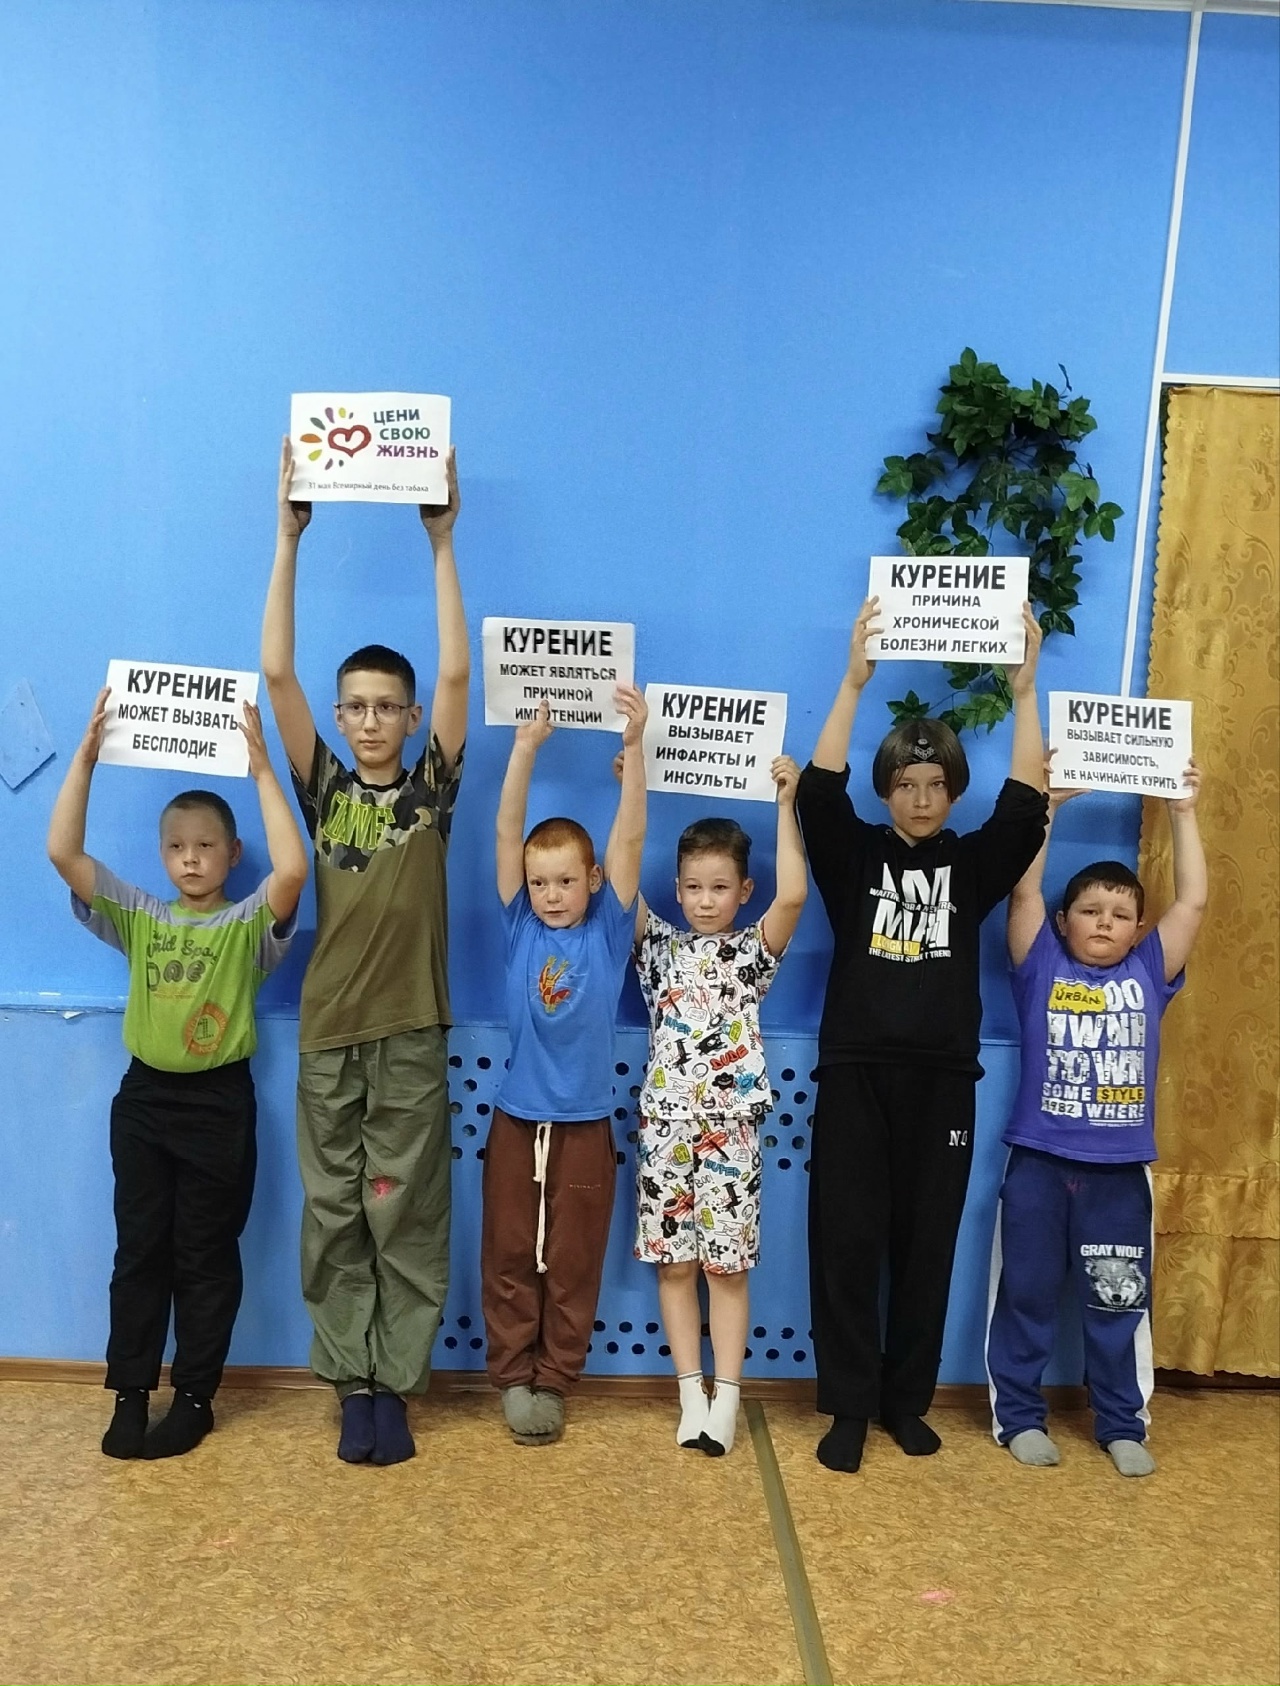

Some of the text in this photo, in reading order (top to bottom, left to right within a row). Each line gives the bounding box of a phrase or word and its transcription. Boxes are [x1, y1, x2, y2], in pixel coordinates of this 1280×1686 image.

[374, 409, 420, 426] ЦЕНИ
[380, 428, 430, 440] СВОЮ
[376, 445, 438, 458] ЖИЗНЬ
[333, 482, 372, 490] Всемирный
[392, 483, 404, 491] без
[891, 564, 1006, 590] КУРЕНИЕ
[912, 595, 981, 607] ПРИЧИНА
[893, 617, 999, 630] ХРОНИЧЕСКОЙ
[504, 627, 612, 656] КУРЕНИЕ
[881, 639, 1008, 653] БОЛЕЗНИ ЛЕГКИХ
[500, 664, 616, 680] МОЖЕТ ЯВЛЯТЬСЯ
[128, 669, 237, 703] КУРЕНИЕ
[524, 687, 593, 701] ПРИЧИНОЙ
[118, 704, 238, 730] МОЖЕТ ВЫЗВАТЬ
[662, 692, 767, 725] КУРЕНИЕ
[1069, 700, 1171, 730] КУРЕНИЕ
[668, 725, 754, 744] ВЫЗЫВАЕТ
[1067, 729, 1173, 748] ВЫЗЫВАЕТ СИЛЬНУЮ
[133, 734, 217, 759] БЕСПЛОДИЕ
[656, 747, 756, 768] ИНФАРКТЫ И
[1083, 751, 1158, 768] ЗАВИСИМОСТЬ,
[664, 770, 747, 789] ИНСУЛЬТЫ
[1064, 769, 1177, 789] НЕ НАЧИНАЙТЕ КУРИТЬ
[868, 947, 882, 956] THE
[881, 951, 904, 962] LATEST
[1055, 987, 1101, 1004] URBAN
[710, 1044, 748, 1071] DUDE
[1042, 1082, 1143, 1101] SOME STYLE
[1086, 1104, 1144, 1119] WHERE
[1080, 1244, 1145, 1258] GRAY WOLF
